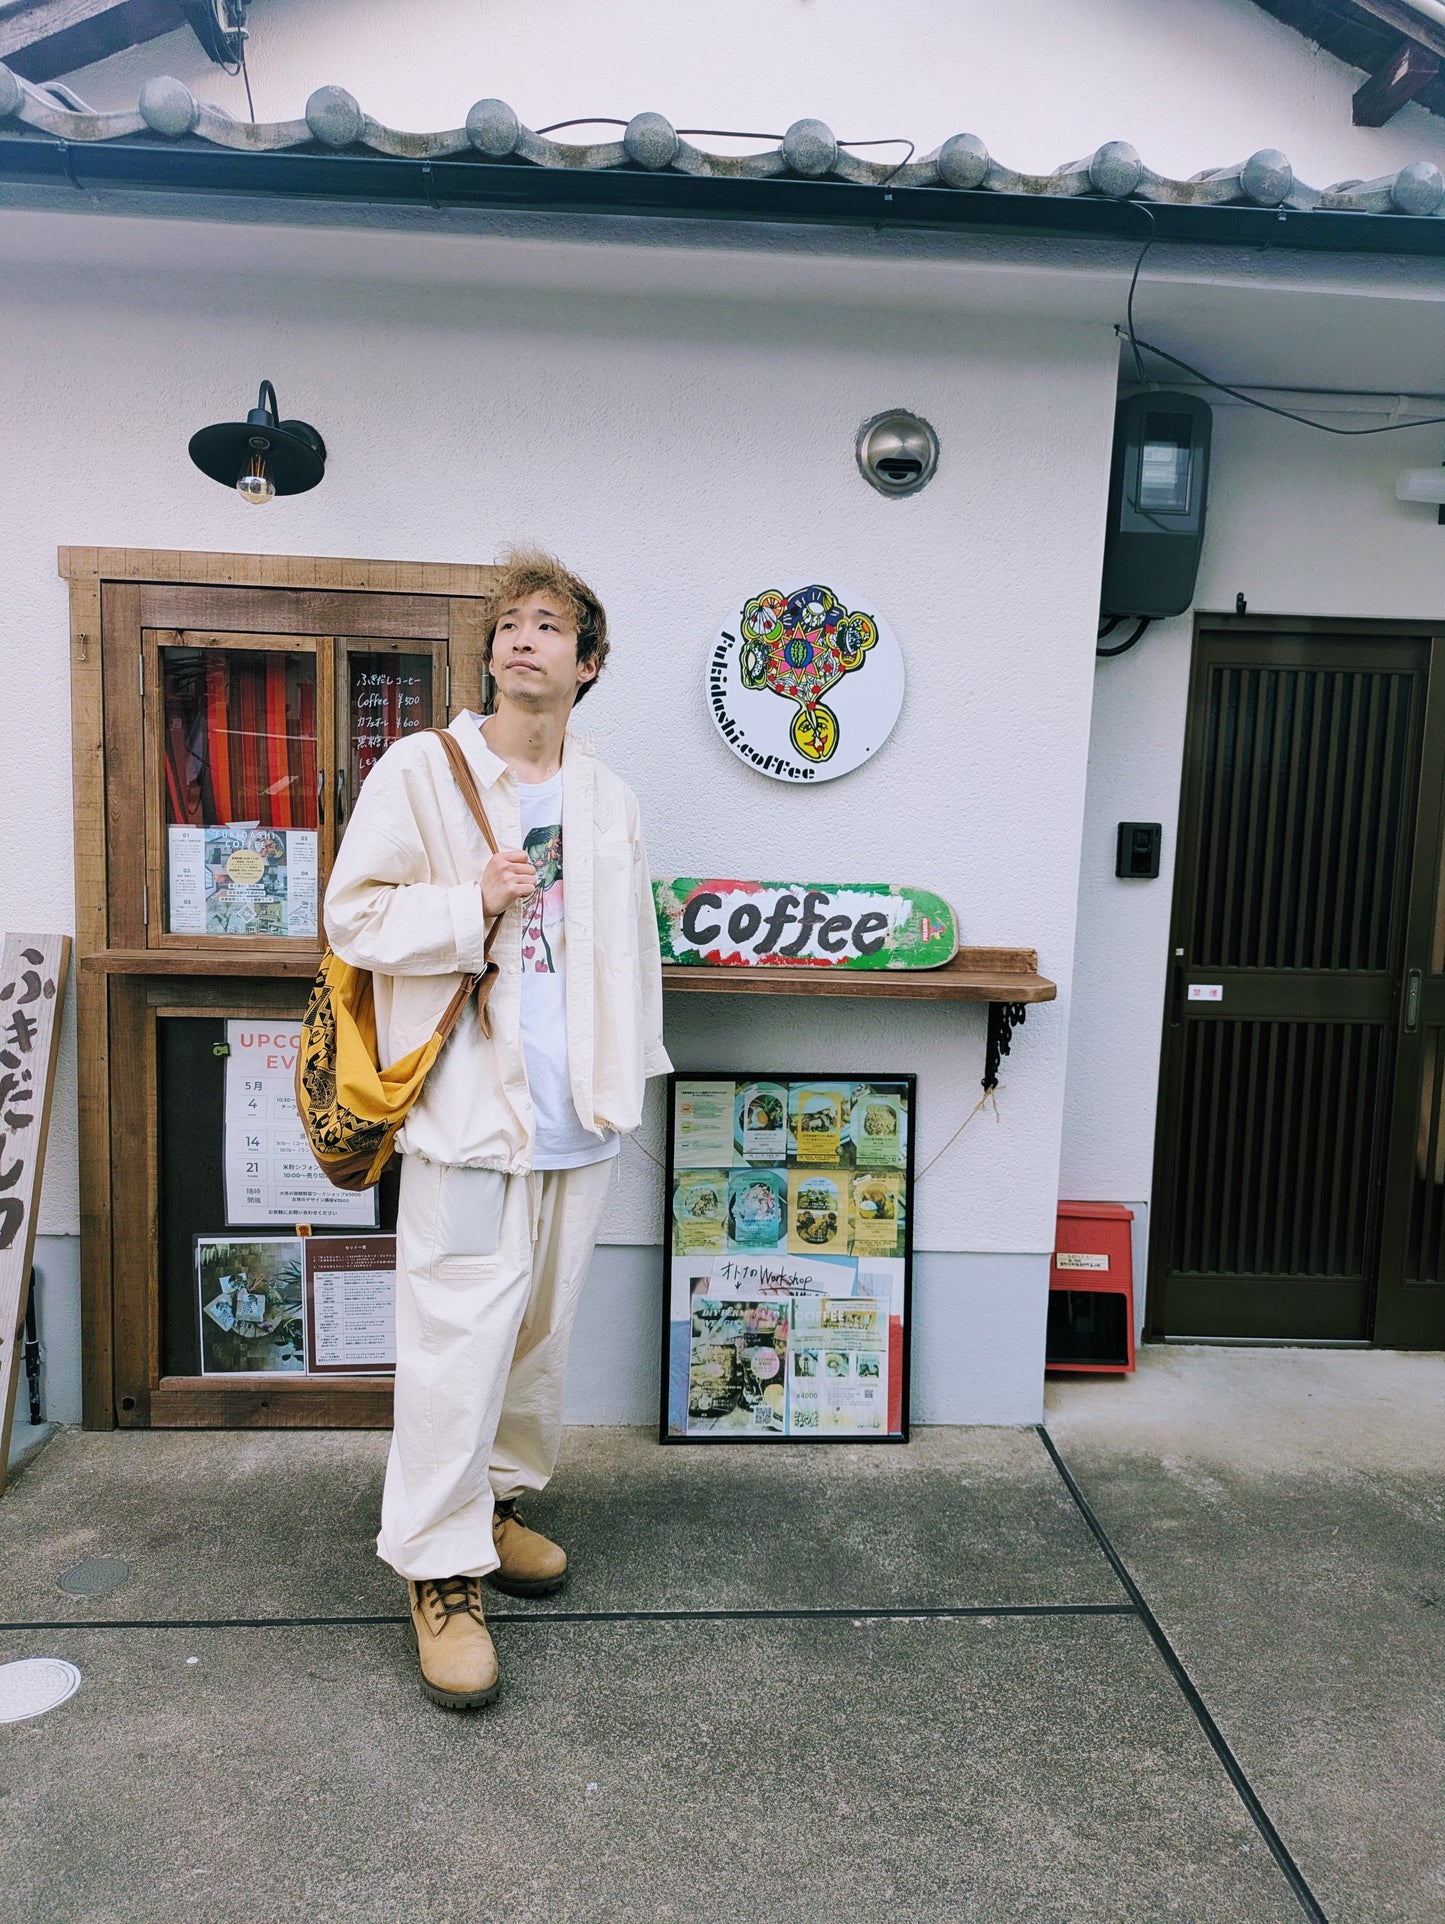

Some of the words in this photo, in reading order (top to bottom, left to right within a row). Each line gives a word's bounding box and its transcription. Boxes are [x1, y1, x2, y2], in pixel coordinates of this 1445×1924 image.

[357, 692, 389, 708] Coffee
[398, 693, 420, 708] ¥500
[396, 717, 420, 728] ¥600
[357, 735, 397, 750] 黒糖オー
[682, 892, 889, 955] Coffee
[240, 1033, 300, 1048] UPCO
[248, 1099, 257, 1108] 4
[245, 1136, 260, 1146] 14
[246, 1162, 259, 1172] 21
